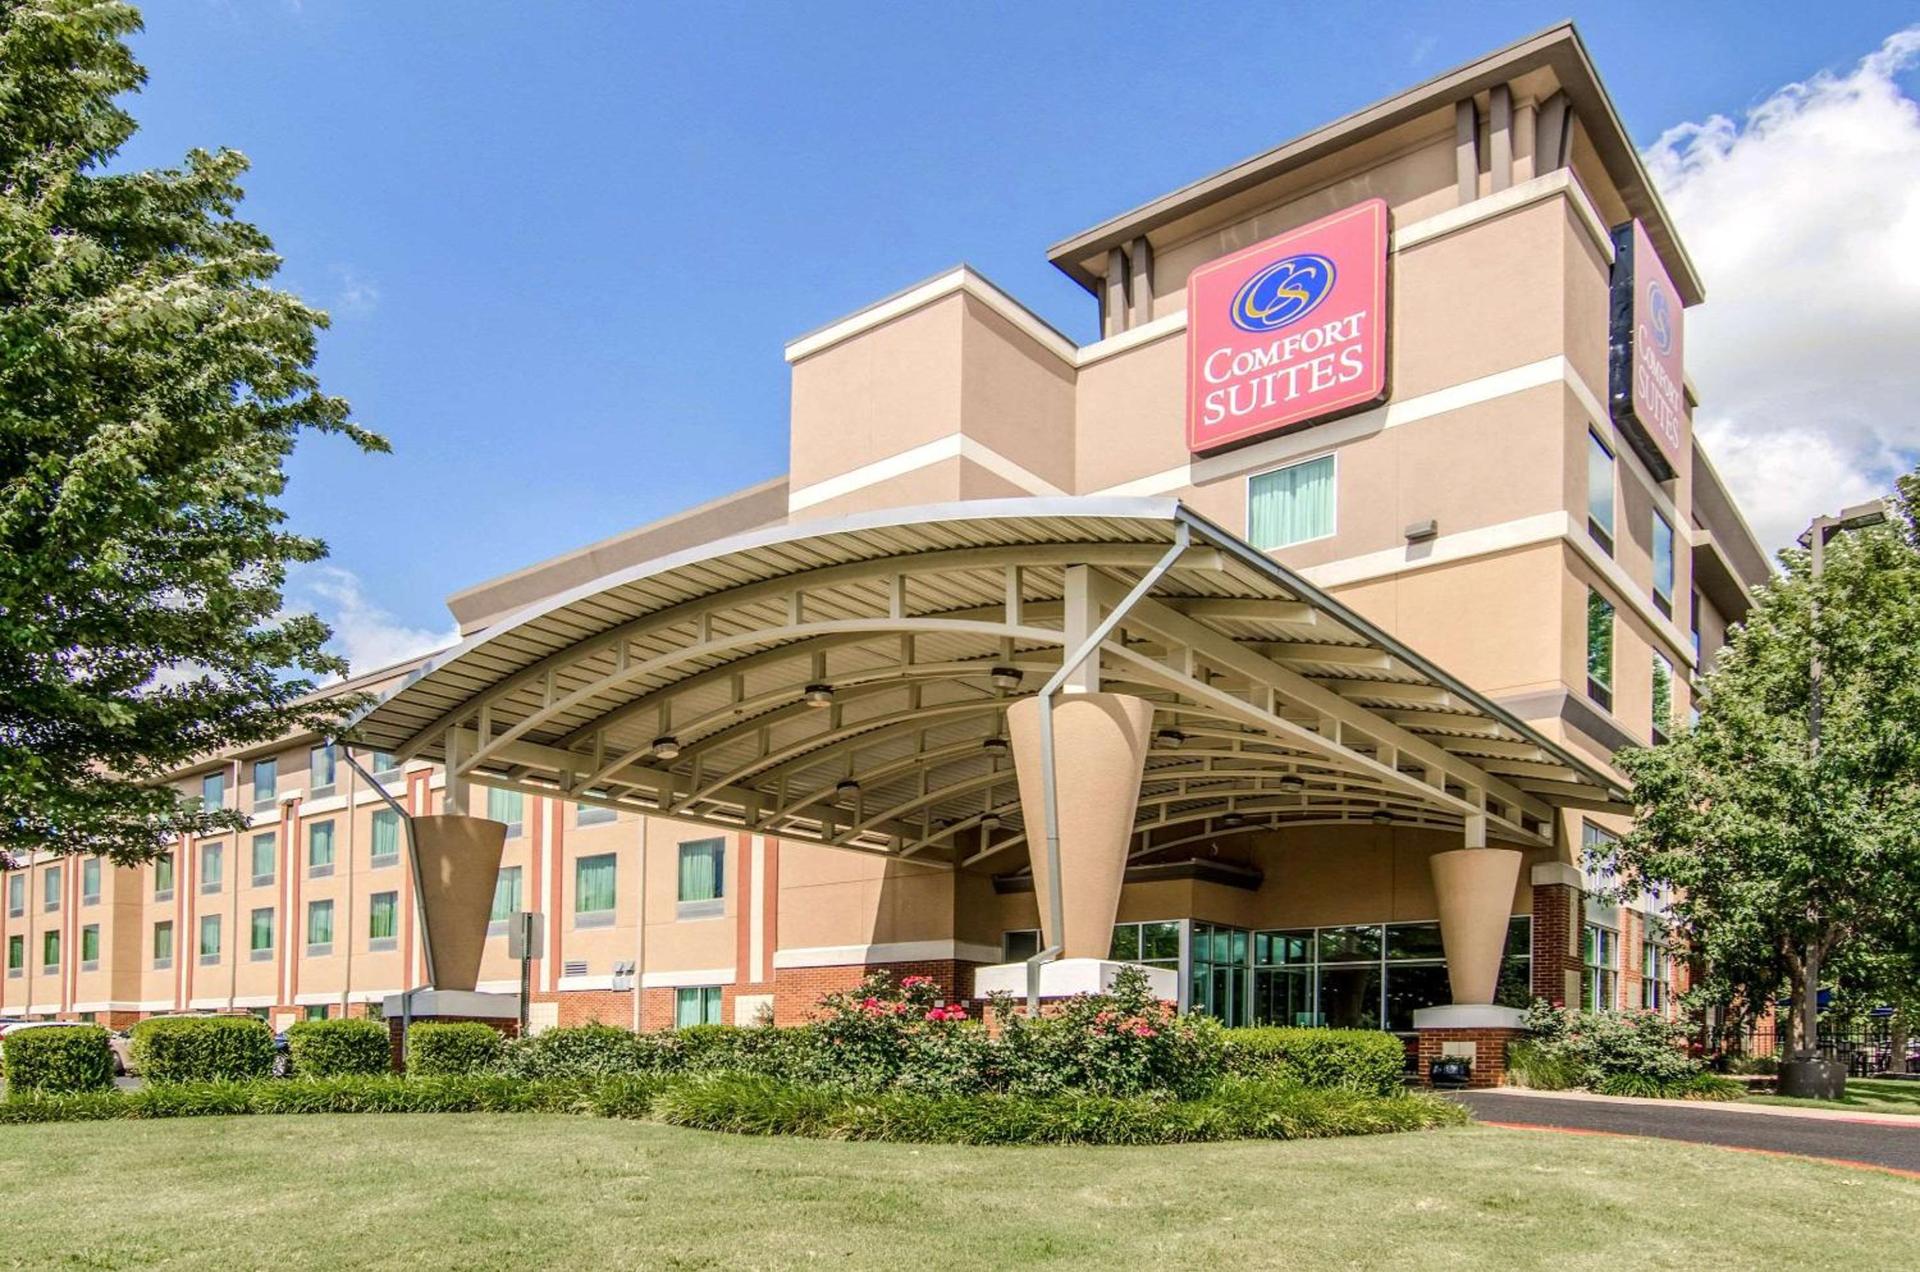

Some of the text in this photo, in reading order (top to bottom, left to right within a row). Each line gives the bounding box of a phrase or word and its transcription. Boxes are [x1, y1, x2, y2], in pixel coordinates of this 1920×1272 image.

[1203, 311, 1367, 384] COMFORT
[1203, 345, 1365, 427] SUITES
[1637, 364, 1680, 449] SUITES
